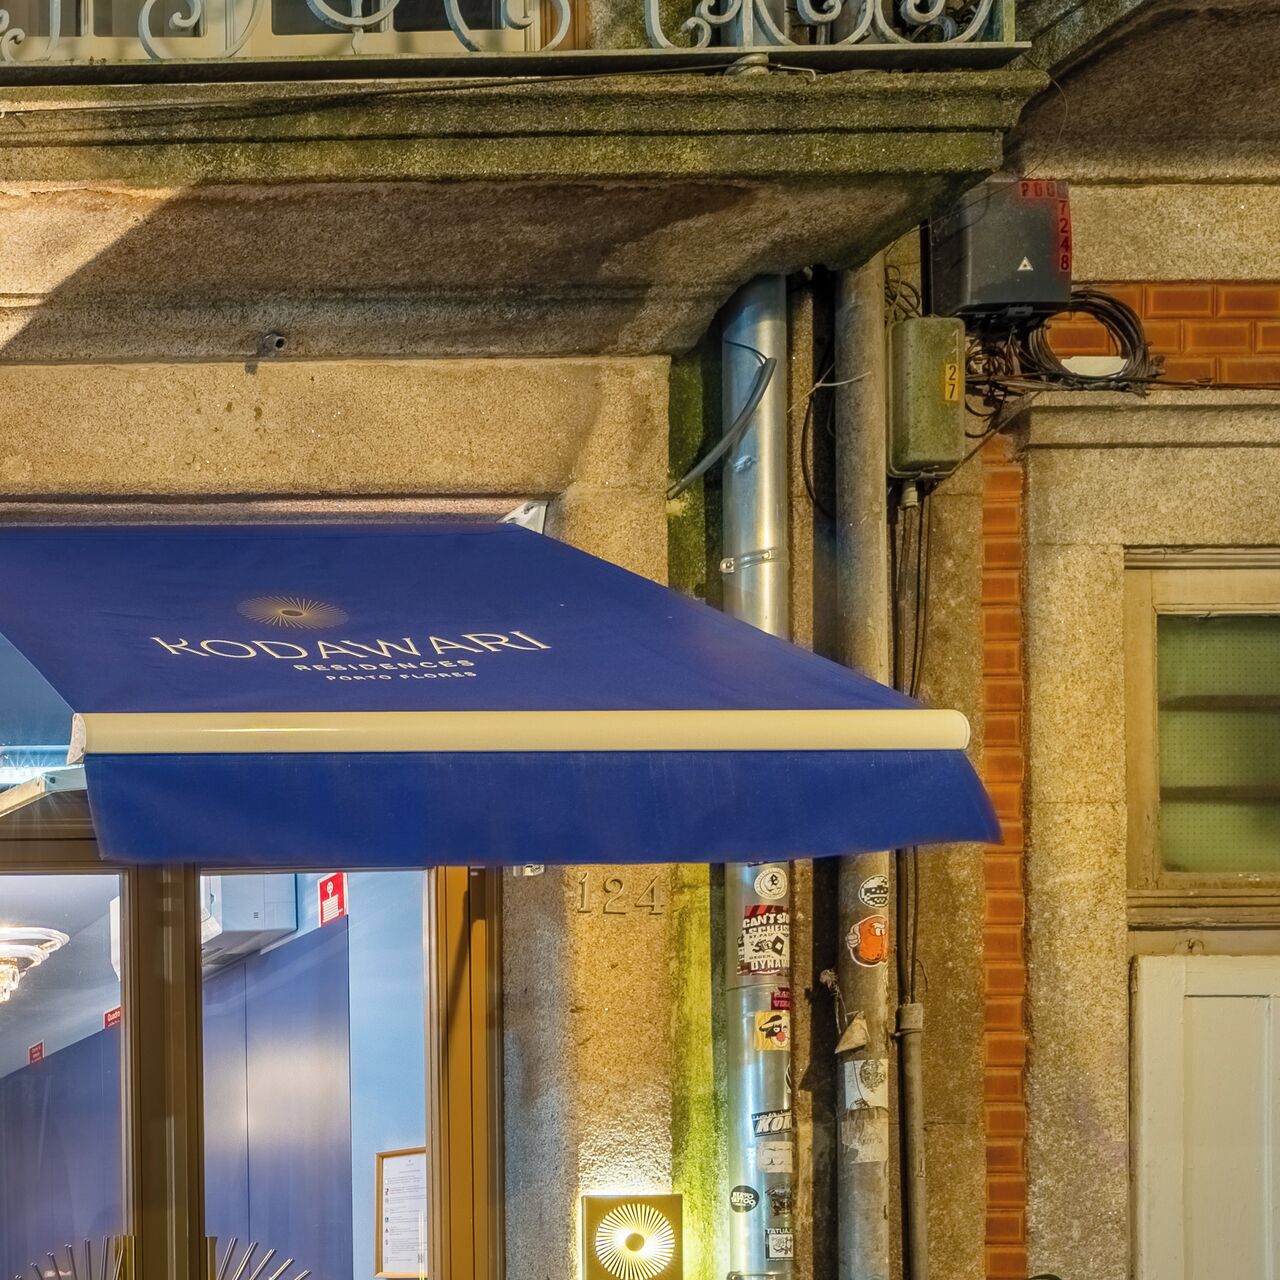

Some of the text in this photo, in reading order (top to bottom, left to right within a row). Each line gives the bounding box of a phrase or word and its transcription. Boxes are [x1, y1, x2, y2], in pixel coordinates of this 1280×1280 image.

[150, 630, 553, 660] KODAWARI
[292, 659, 476, 673] RESIDENCES
[576, 872, 670, 916] 124
